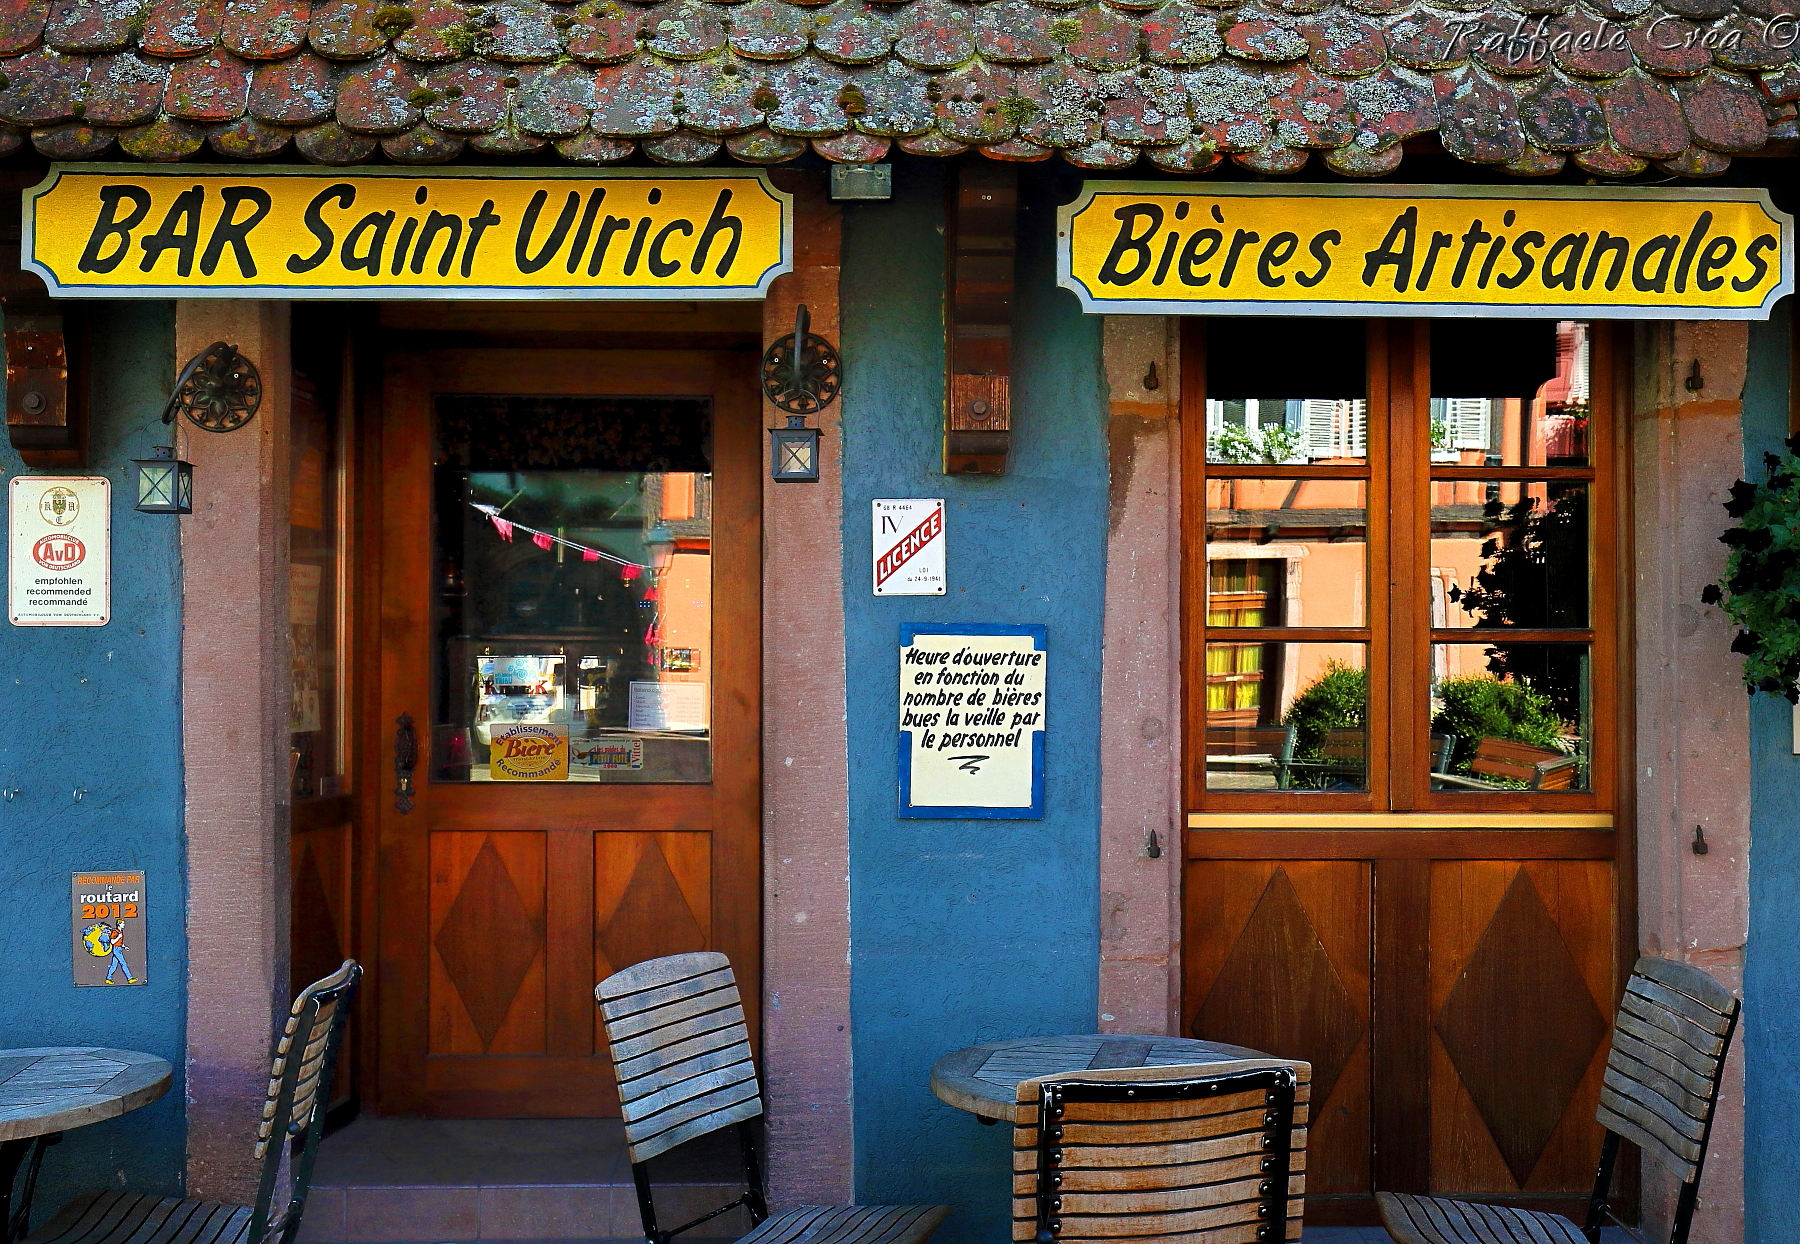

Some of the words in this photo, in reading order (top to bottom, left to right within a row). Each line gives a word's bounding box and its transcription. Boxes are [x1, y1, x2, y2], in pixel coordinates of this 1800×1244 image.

[78, 183, 272, 279] BAR
[287, 183, 500, 278] Saint
[516, 186, 743, 279] Ulrich
[1098, 201, 1342, 288] Bières
[1363, 206, 1778, 293] Artisanales
[881, 515, 904, 535] IV
[43, 543, 76, 562] AvD
[879, 513, 939, 581] LICENCE
[35, 577, 83, 586] empfohlen
[26, 587, 92, 596] recommended
[29, 597, 88, 606] recommandé
[905, 648, 951, 665] Heure
[952, 646, 1042, 666] d'ouverture
[914, 670, 933, 685] en
[936, 667, 1000, 685] fonction
[1004, 669, 1025, 685] du
[903, 688, 964, 706] nombre
[967, 688, 986, 706] de
[992, 687, 1043, 706] bières
[902, 708, 941, 727] bues
[945, 708, 960, 726] la
[965, 707, 1006, 726] veille
[1010, 712, 1041, 730] par
[494, 724, 563, 748] Etablissement
[921, 729, 935, 748] le
[938, 728, 1023, 751] personnel
[503, 738, 557, 758] Bière
[631, 739, 641, 763] Vittel
[496, 758, 562, 778] Recommandé
[592, 754, 610, 764] PETIT
[77, 874, 126, 884] RECOMMANDÉ
[126, 874, 140, 883] PAR
[105, 883, 113, 891] le
[80, 890, 139, 904] routard
[81, 903, 139, 919] 2012
